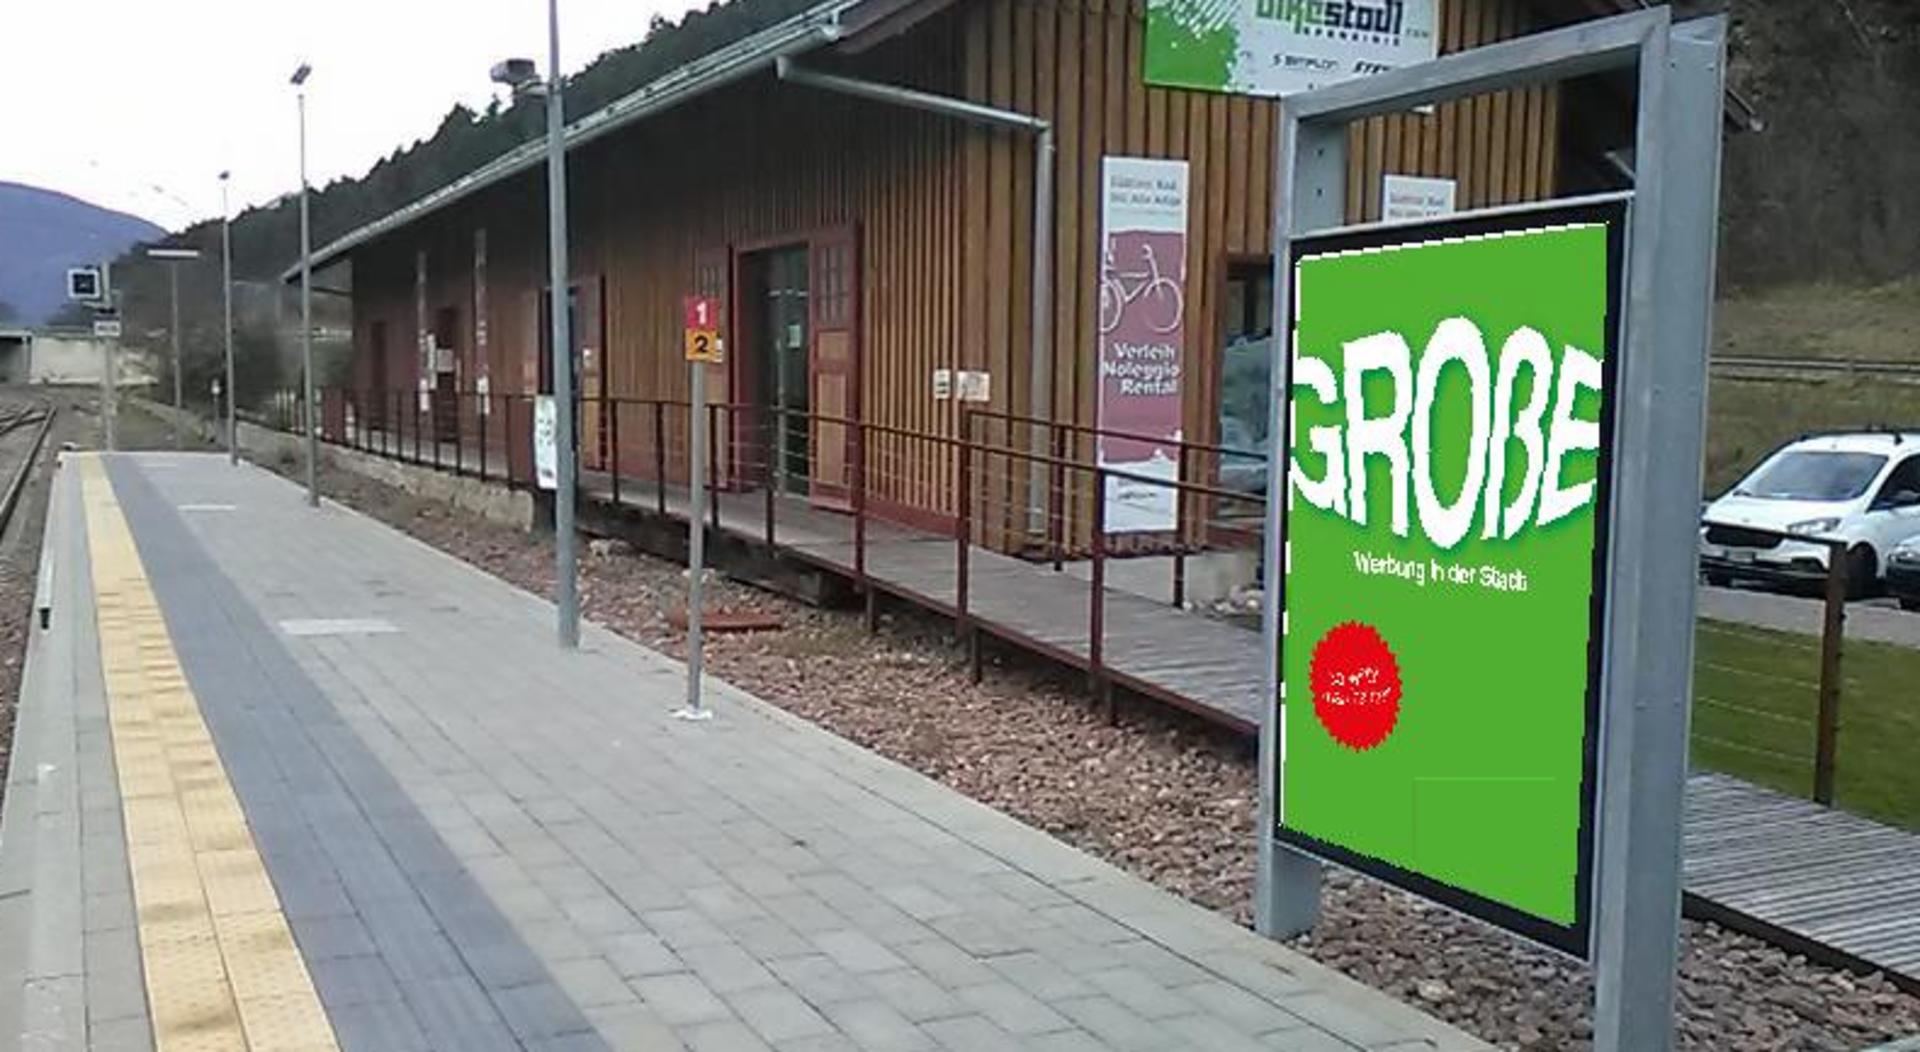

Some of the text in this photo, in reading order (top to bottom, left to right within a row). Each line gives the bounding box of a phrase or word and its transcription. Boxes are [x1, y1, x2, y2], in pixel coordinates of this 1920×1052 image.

[696, 302, 707, 325] 1
[694, 335, 709, 353] 2
[1113, 342, 1176, 361] Verleih
[1102, 360, 1181, 380] Noleggio
[1120, 379, 1178, 395] Rental
[1353, 550, 1426, 588] Werbung
[1447, 562, 1477, 585] der
[1479, 564, 1528, 592] Stadt
